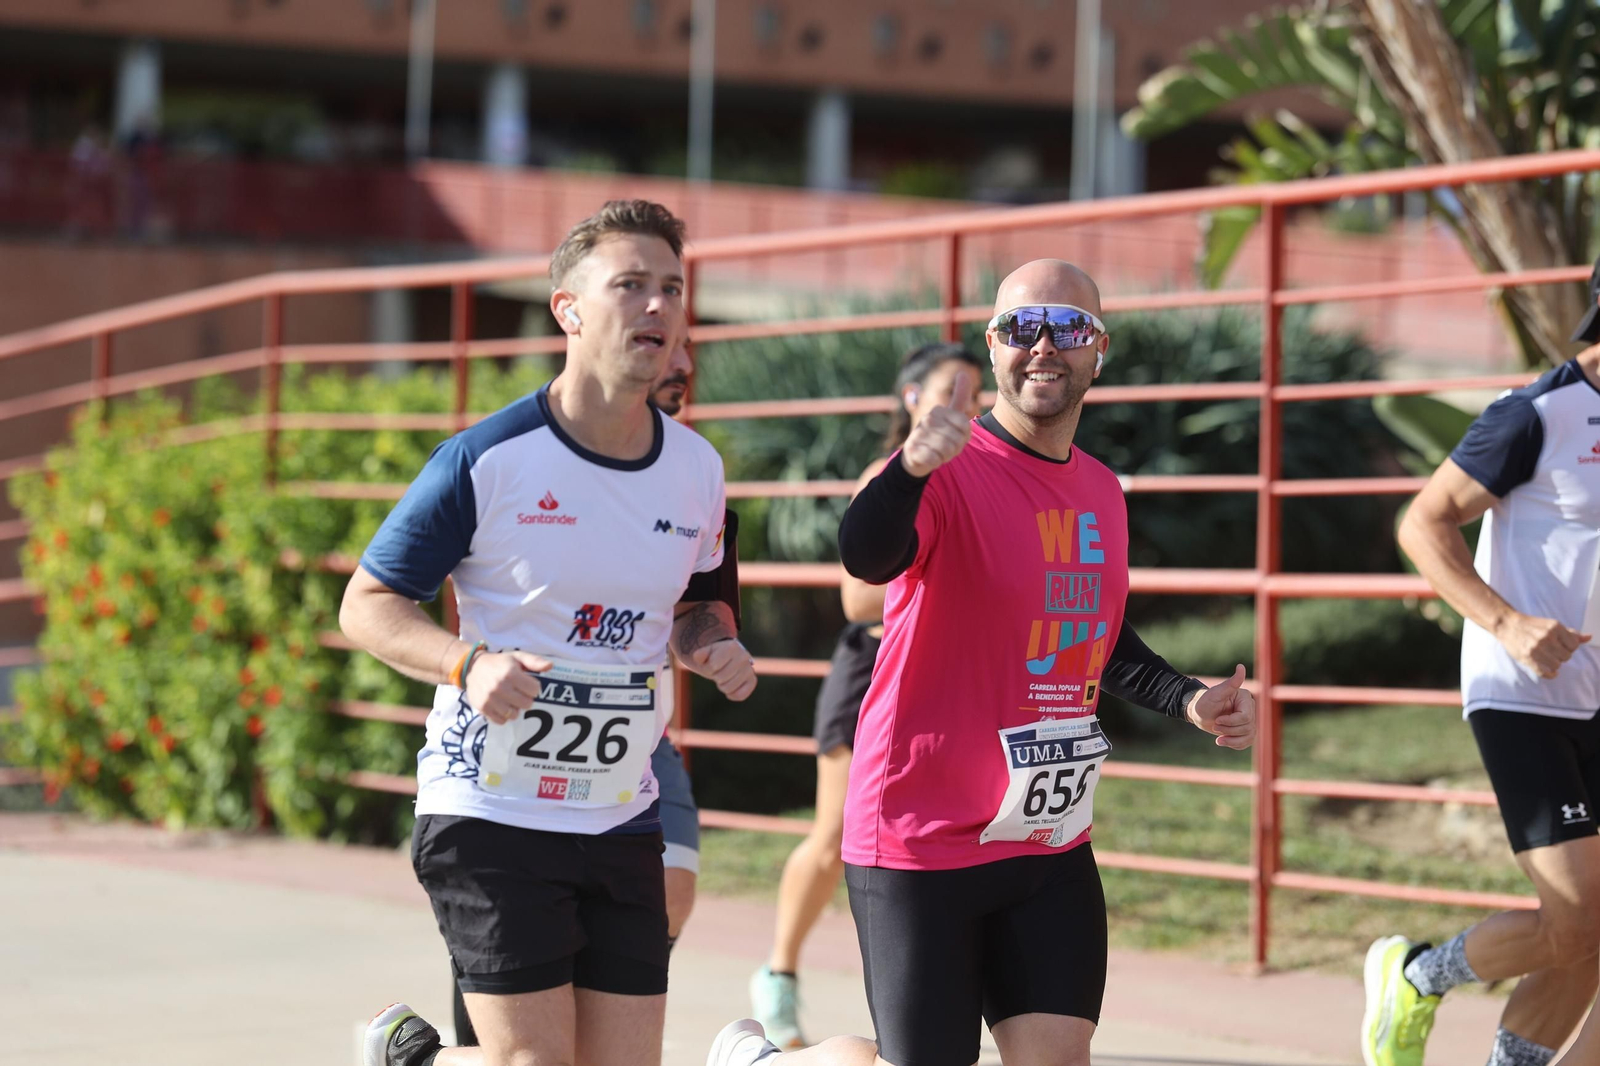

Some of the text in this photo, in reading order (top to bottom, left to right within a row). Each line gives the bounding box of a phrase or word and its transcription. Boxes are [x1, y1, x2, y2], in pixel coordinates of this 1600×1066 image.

[516, 512, 578, 526] Santander
[1036, 508, 1105, 564] WE
[1049, 574, 1098, 610] RUN
[1026, 619, 1107, 677] UMA
[536, 682, 579, 705] MA
[1029, 683, 1081, 692] CARRERA POPULAR
[1035, 693, 1064, 701] BENEFICIO
[516, 709, 631, 765] 226
[1013, 743, 1066, 764] UMA
[540, 780, 567, 796] WE
[570, 779, 592, 787] RUN
[567, 792, 590, 800] RUN
[1030, 832, 1052, 843] WE
